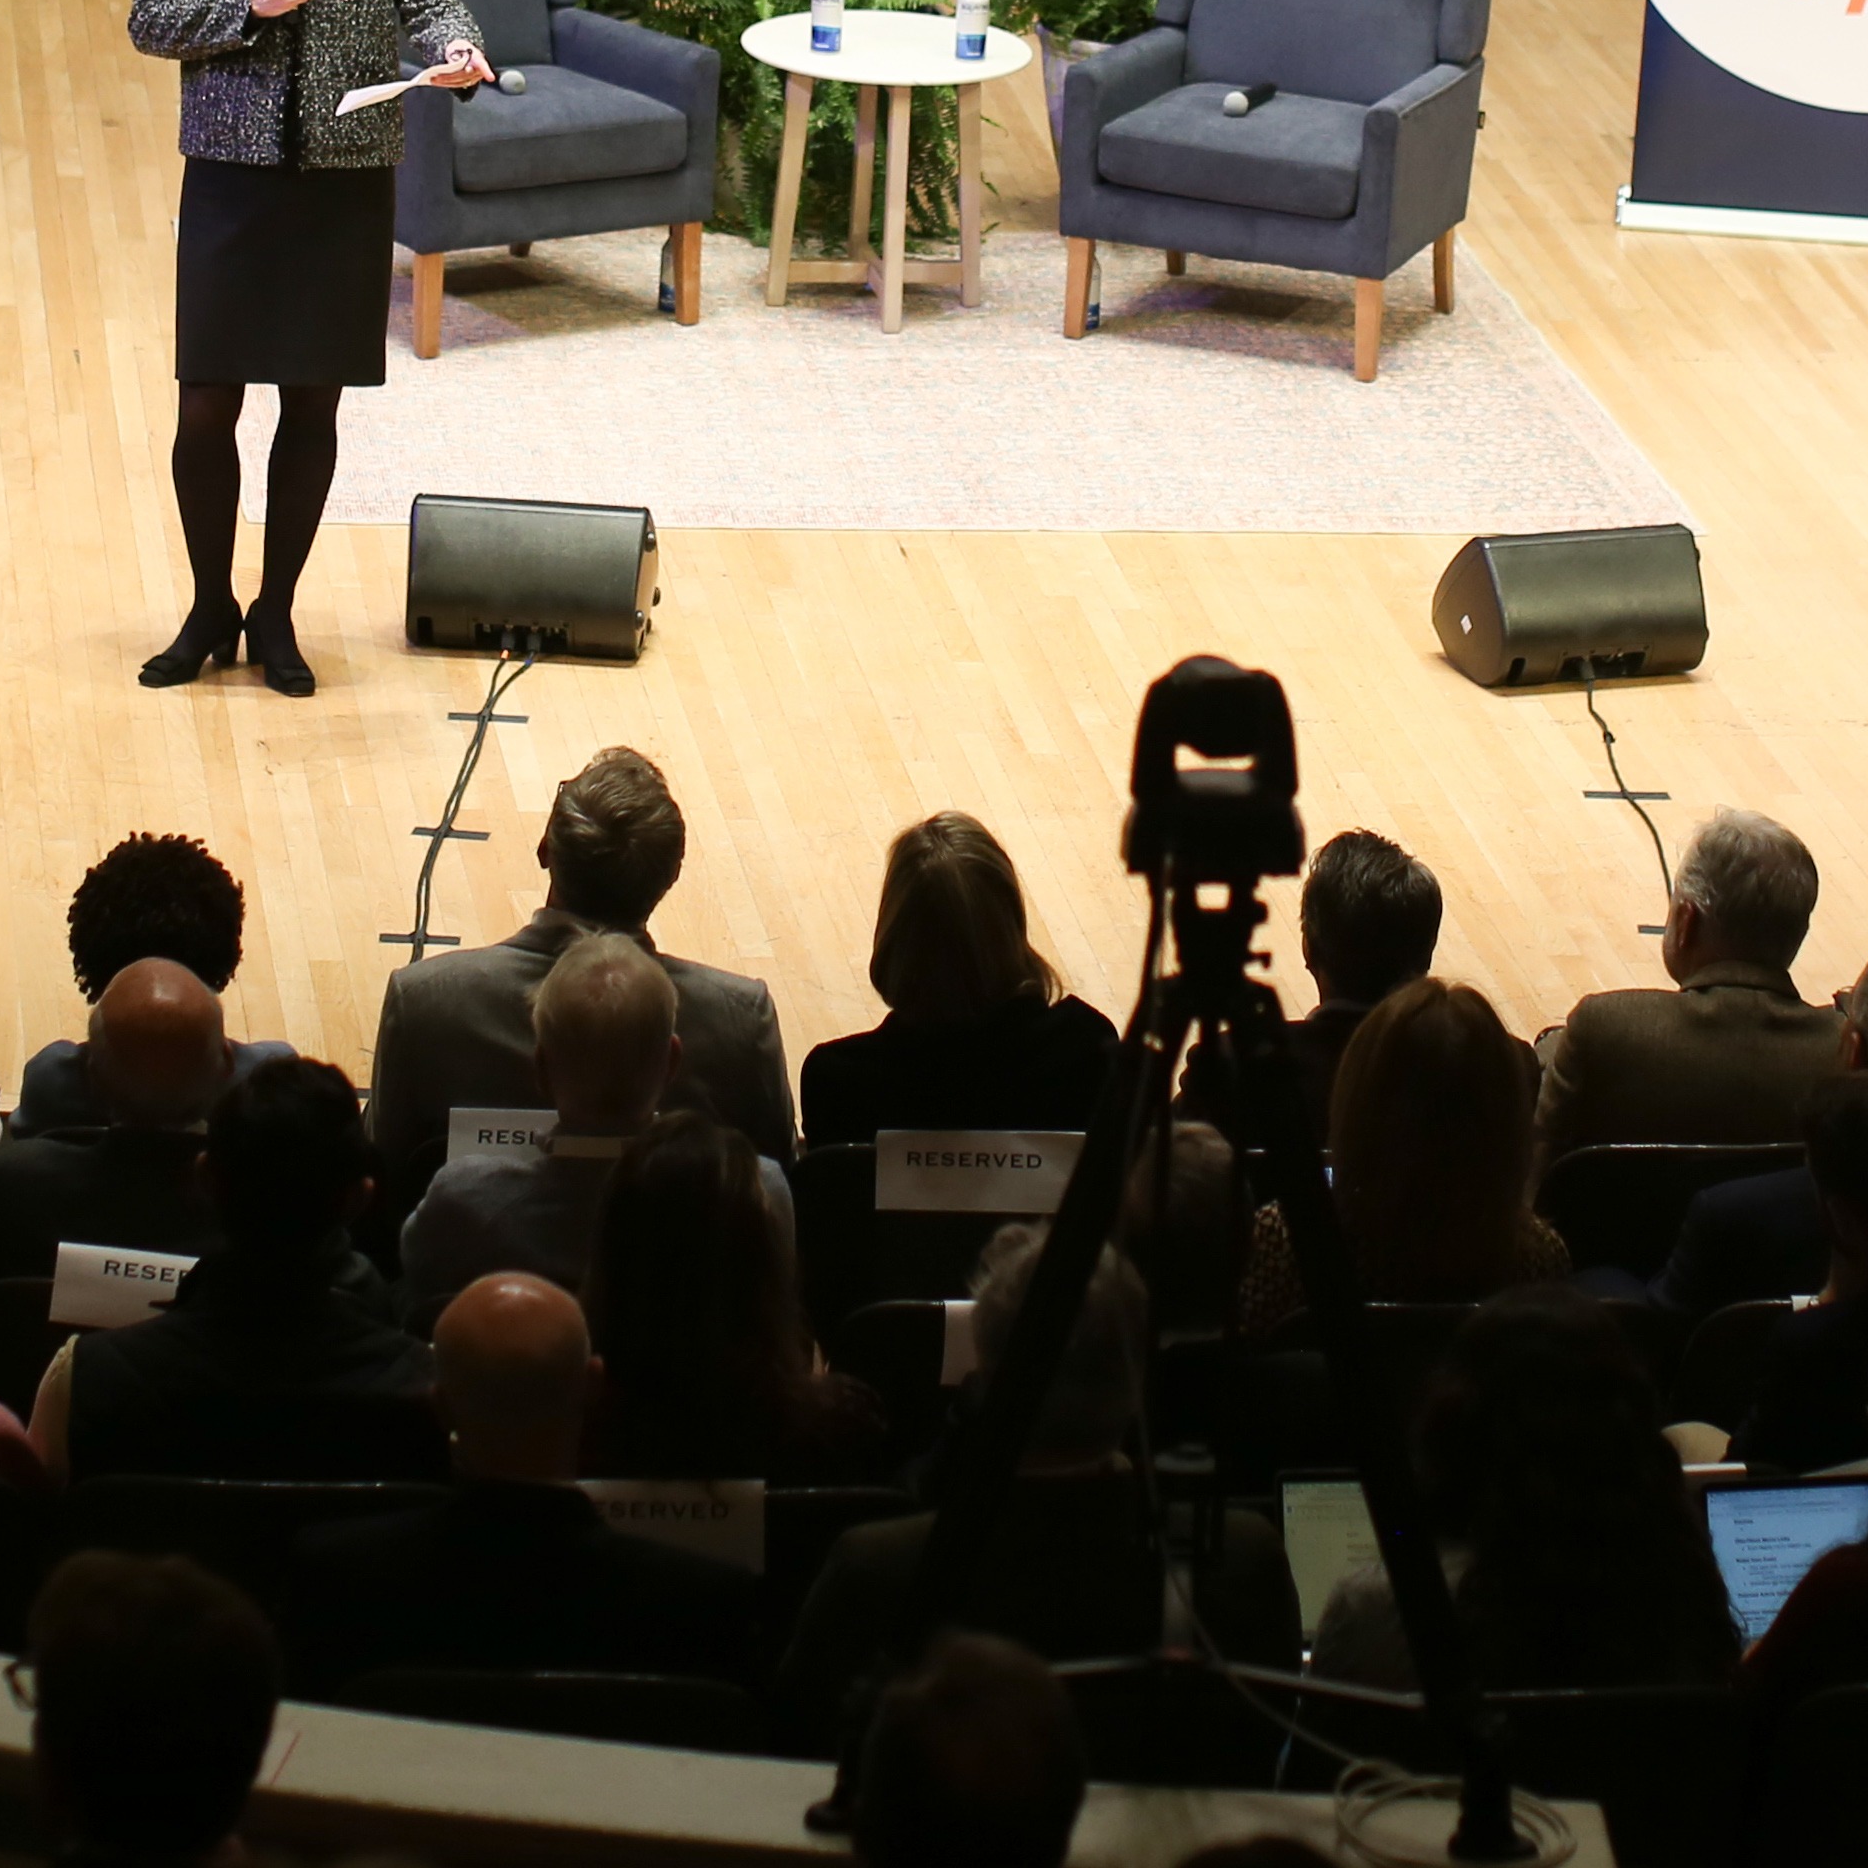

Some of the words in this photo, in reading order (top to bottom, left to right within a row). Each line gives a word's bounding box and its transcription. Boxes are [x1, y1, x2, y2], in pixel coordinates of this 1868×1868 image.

[906, 1150, 1043, 1170] RESERVED
[103, 1259, 189, 1283] RESE
[594, 1500, 730, 1520] ESERVED
